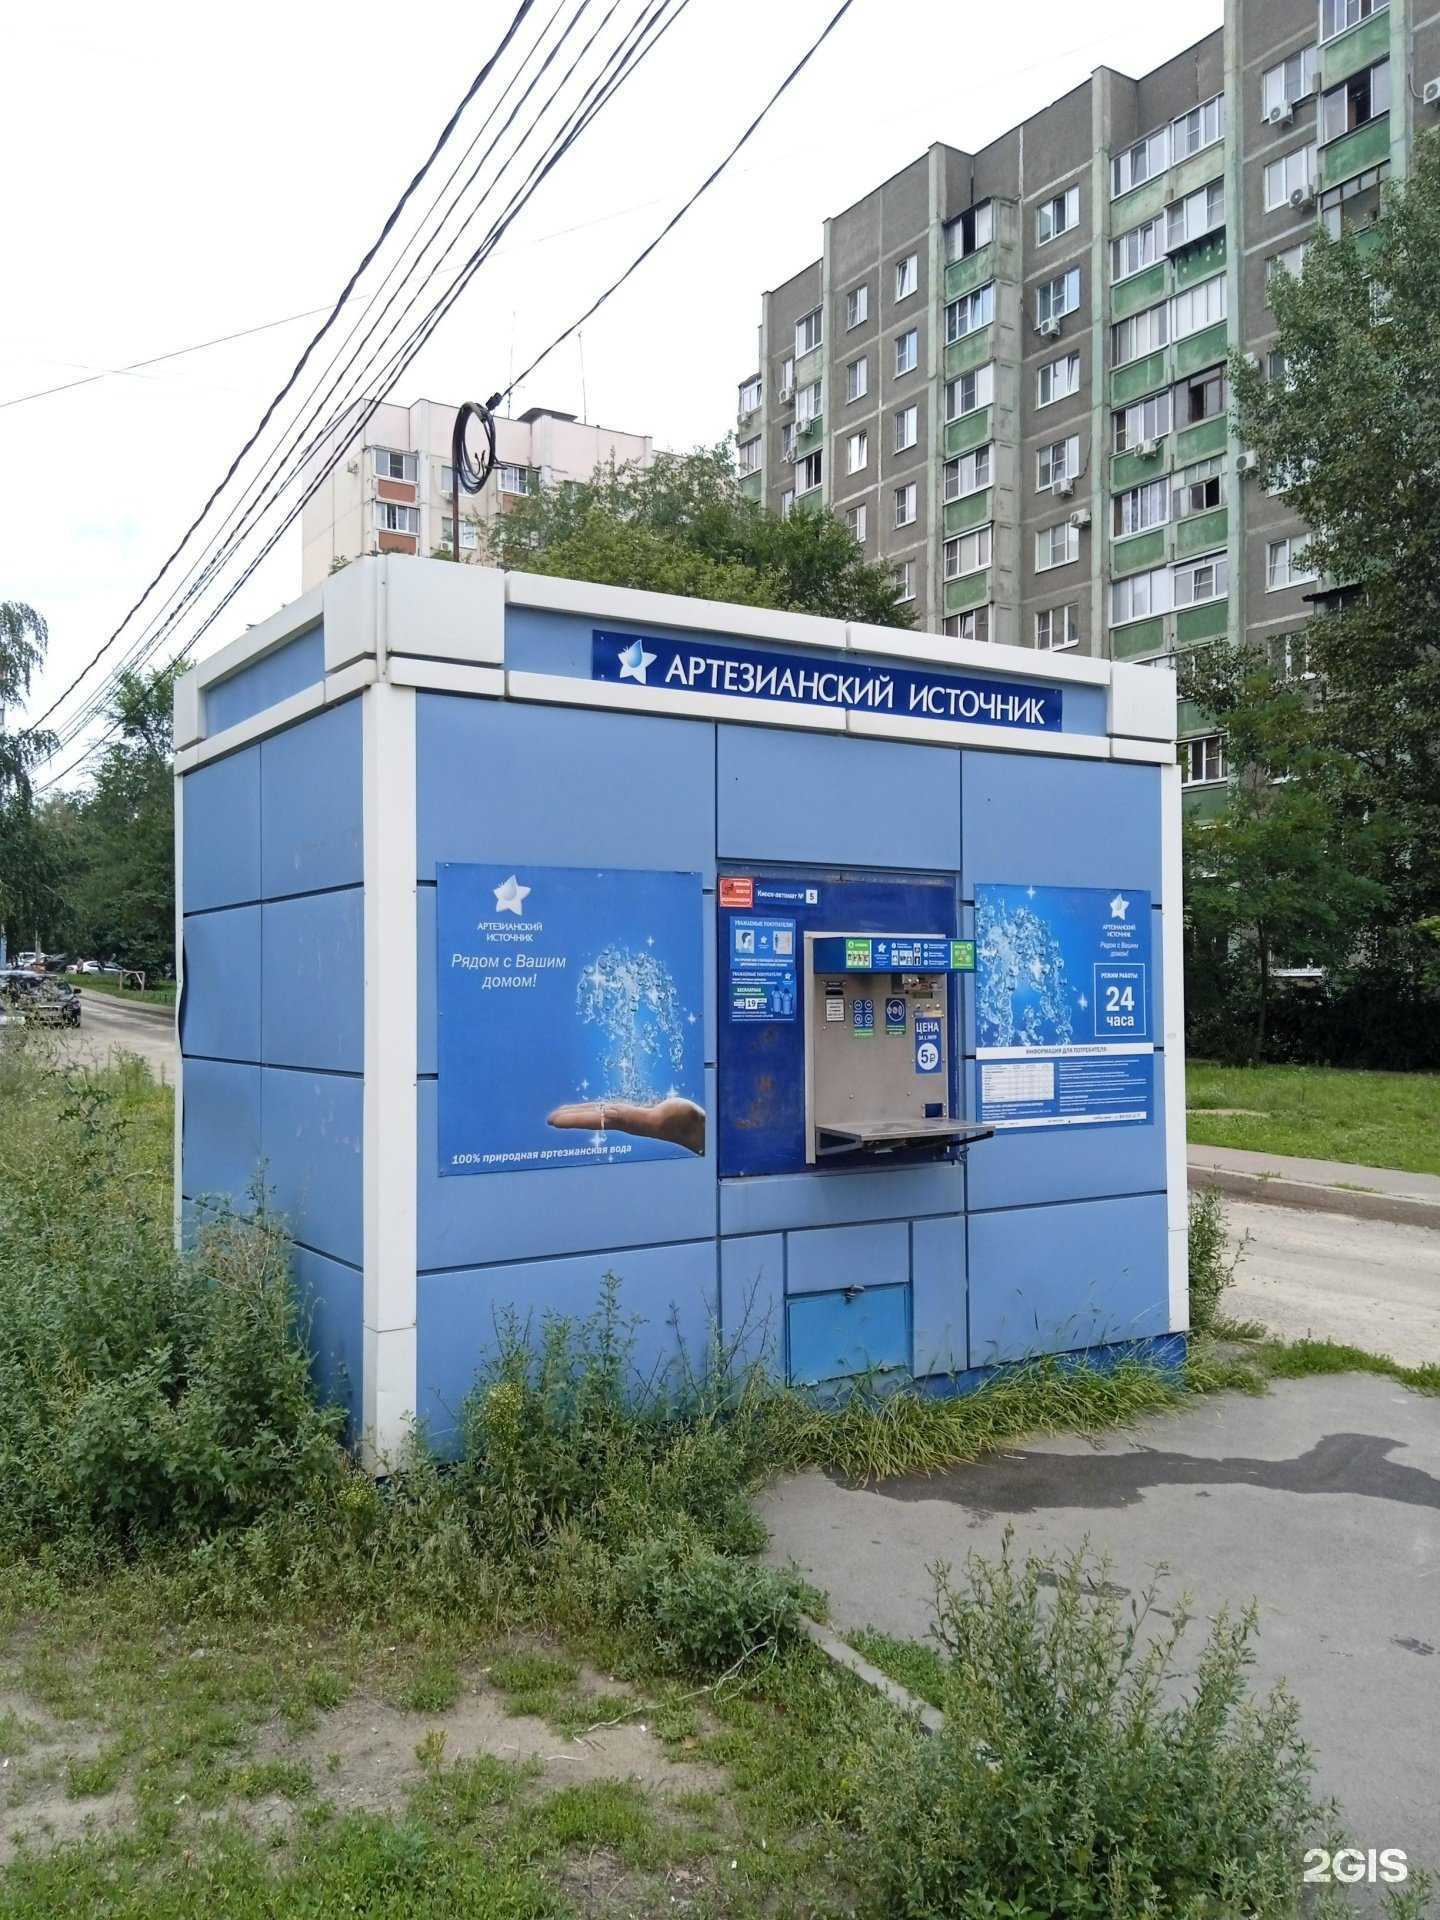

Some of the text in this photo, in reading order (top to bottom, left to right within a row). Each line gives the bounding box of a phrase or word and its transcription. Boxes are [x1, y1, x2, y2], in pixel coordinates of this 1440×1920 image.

[665, 654, 1046, 725] АРТЕЗИАНСКИЙ ИСТОЧНИК
[477, 922, 543, 942] АРТЕЗИАНСКИЙ ИСТОЧНИК
[451, 953, 567, 970] Рядом с Вашим
[481, 973, 537, 990] домом!
[1106, 986, 1135, 1012] 24
[916, 1021, 940, 1034] ЦЕНА
[1106, 1016, 1135, 1027] часа
[452, 1143, 633, 1165] 100% природная артезианская вода
